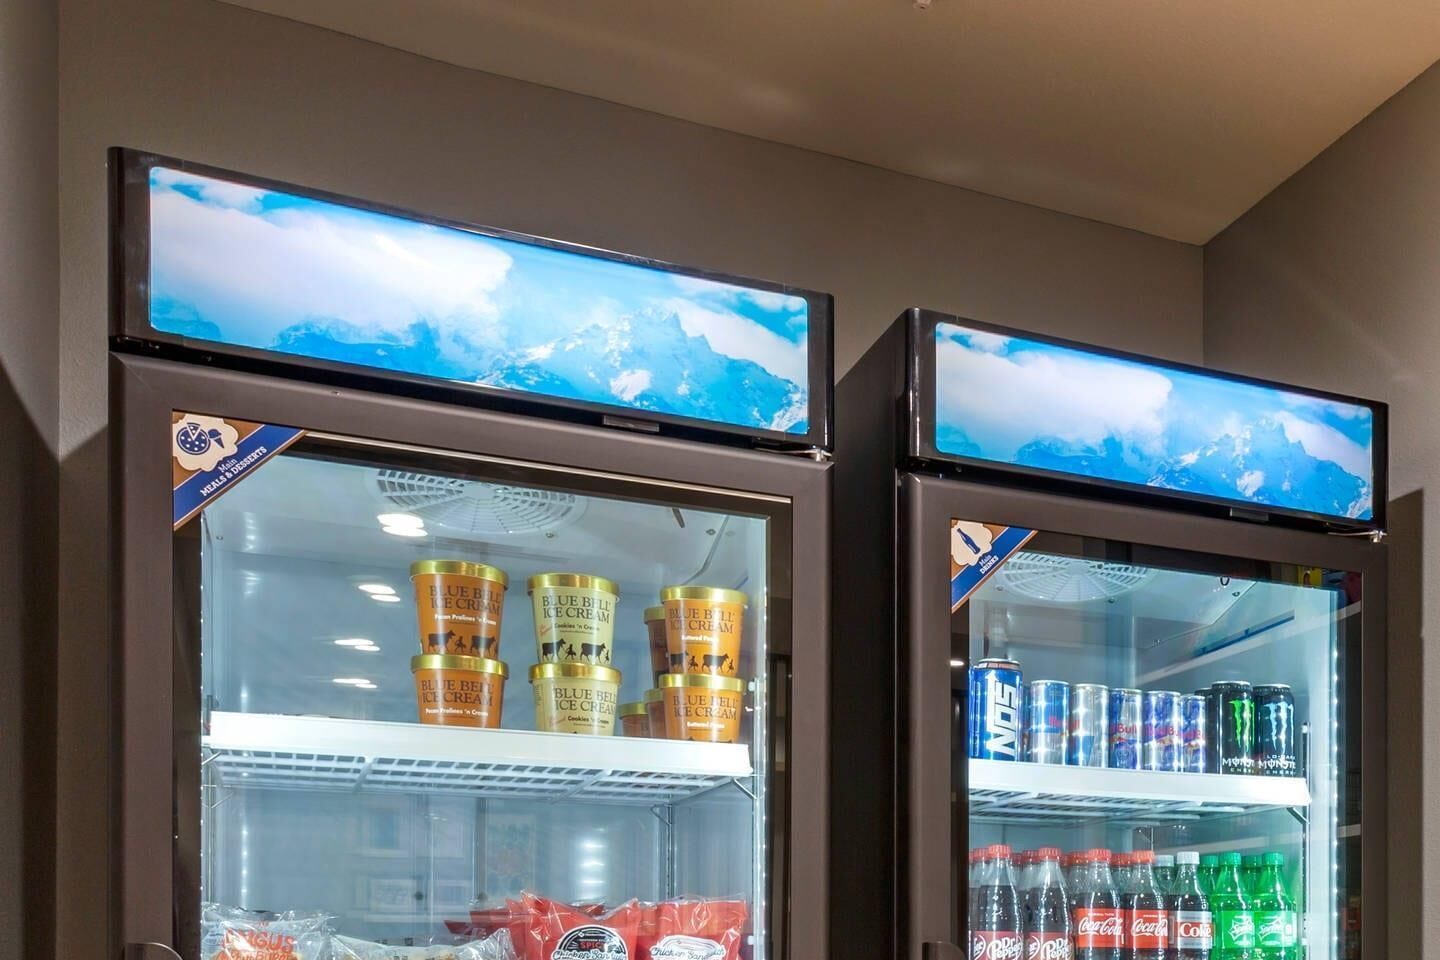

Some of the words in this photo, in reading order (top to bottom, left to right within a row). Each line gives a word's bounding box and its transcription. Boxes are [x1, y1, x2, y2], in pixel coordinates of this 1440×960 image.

[200, 475, 227, 496] MEALS
[226, 471, 233, 480] &
[231, 446, 267, 474] DESSERTS
[218, 459, 237, 473] Main
[429, 585, 468, 597] BLUE
[431, 599, 452, 609] ICE
[456, 599, 500, 616] CREAM
[542, 595, 578, 607] BLUE
[582, 597, 610, 612] BELL
[543, 608, 563, 618] ICE
[571, 608, 610, 624] CREAM
[669, 608, 700, 619] BLUE
[689, 621, 734, 634] CREAM
[422, 680, 454, 692] BLUE
[423, 693, 443, 704] ICE
[554, 688, 591, 700] BLUE
[673, 695, 707, 706] BLUE
[555, 700, 577, 711] ICE
[674, 706, 691, 717] ICE
[693, 706, 736, 721] CREAM
[985, 674, 1018, 758] NOS
[1180, 923, 1211, 937] Coke
[1002, 937, 1016, 948] Dr
